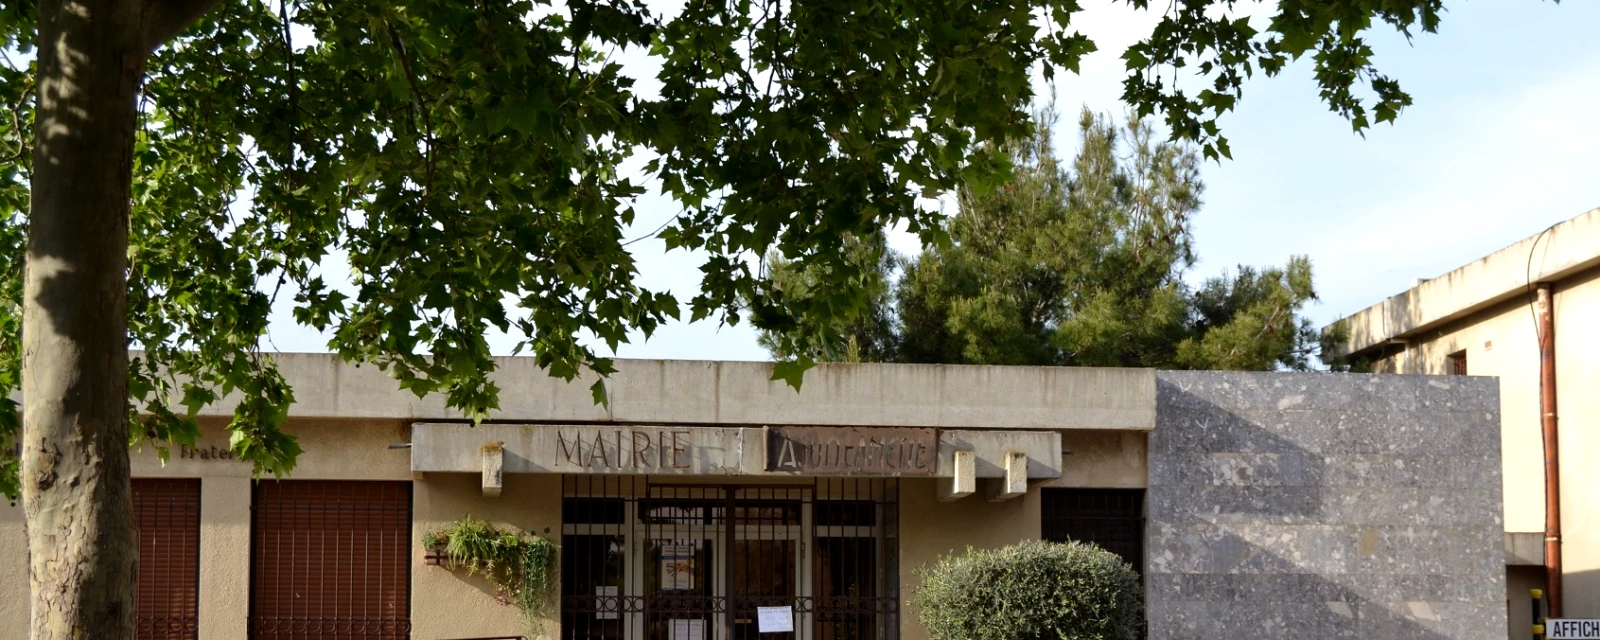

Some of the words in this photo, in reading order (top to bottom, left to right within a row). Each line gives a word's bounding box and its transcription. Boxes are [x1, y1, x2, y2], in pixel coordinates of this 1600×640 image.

[180, 444, 235, 460] Frater
[554, 429, 691, 469] MAIRIE
[1553, 621, 1600, 638] AFFICH
